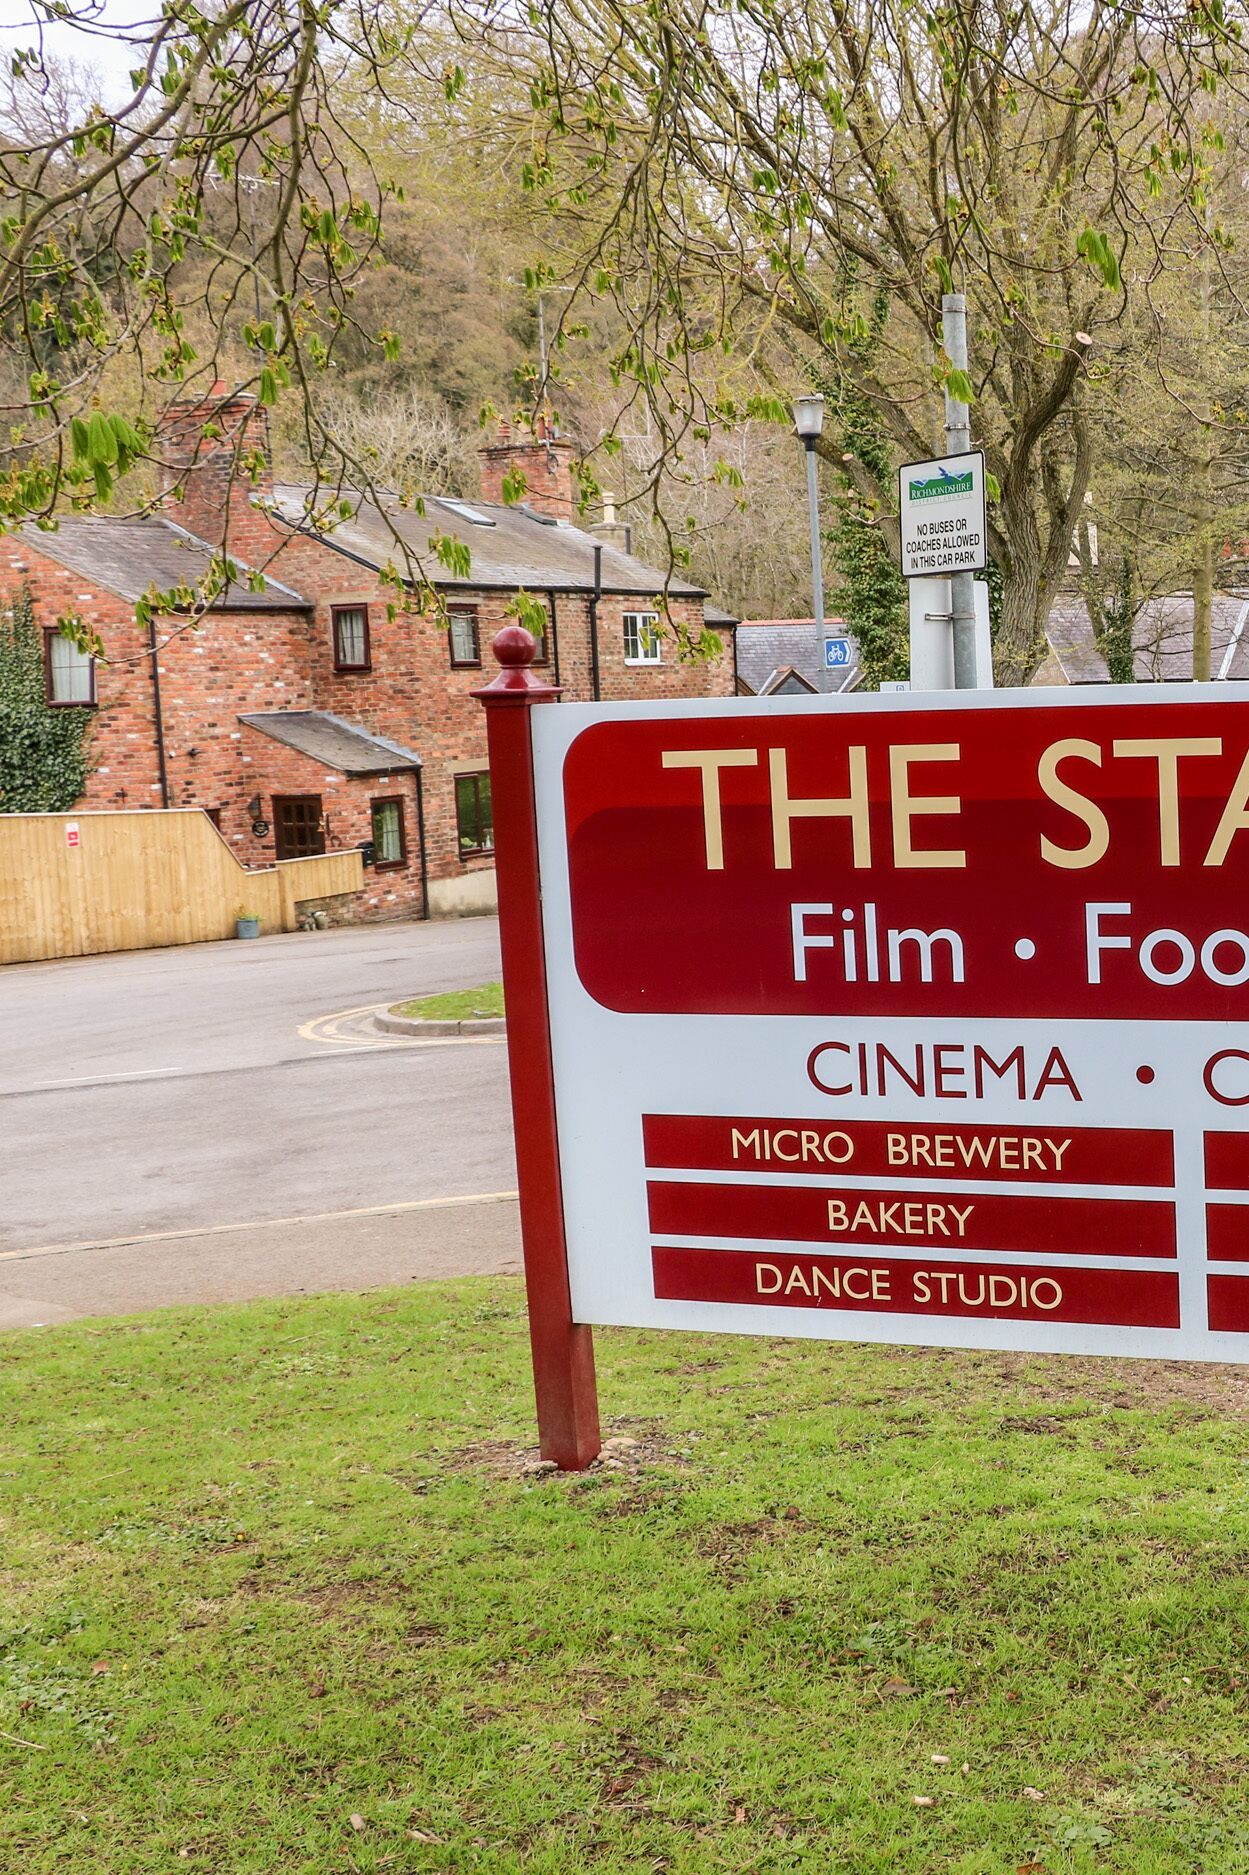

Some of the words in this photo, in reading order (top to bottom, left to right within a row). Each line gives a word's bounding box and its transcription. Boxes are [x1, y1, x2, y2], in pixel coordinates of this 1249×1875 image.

[911, 482, 972, 499] RICHMONDSHIRE
[906, 538, 941, 554] COACHES
[942, 533, 980, 549] ALLOWED
[917, 523, 928, 536] NO
[929, 520, 955, 535] BUSES
[955, 518, 967, 531] OR
[911, 557, 918, 569] IN
[919, 554, 936, 568] THIS
[937, 553, 953, 566] CAR
[954, 550, 976, 564] PARK
[662, 743, 967, 870] THE
[790, 902, 966, 983] Film
[807, 1041, 1083, 1102] CINEMA
[731, 1128, 855, 1164] MICRO
[886, 1133, 1072, 1171] BREWERY
[827, 1199, 975, 1237] BAKERY
[755, 1262, 892, 1302] DANCE
[912, 1270, 1064, 1312] STUDIO
